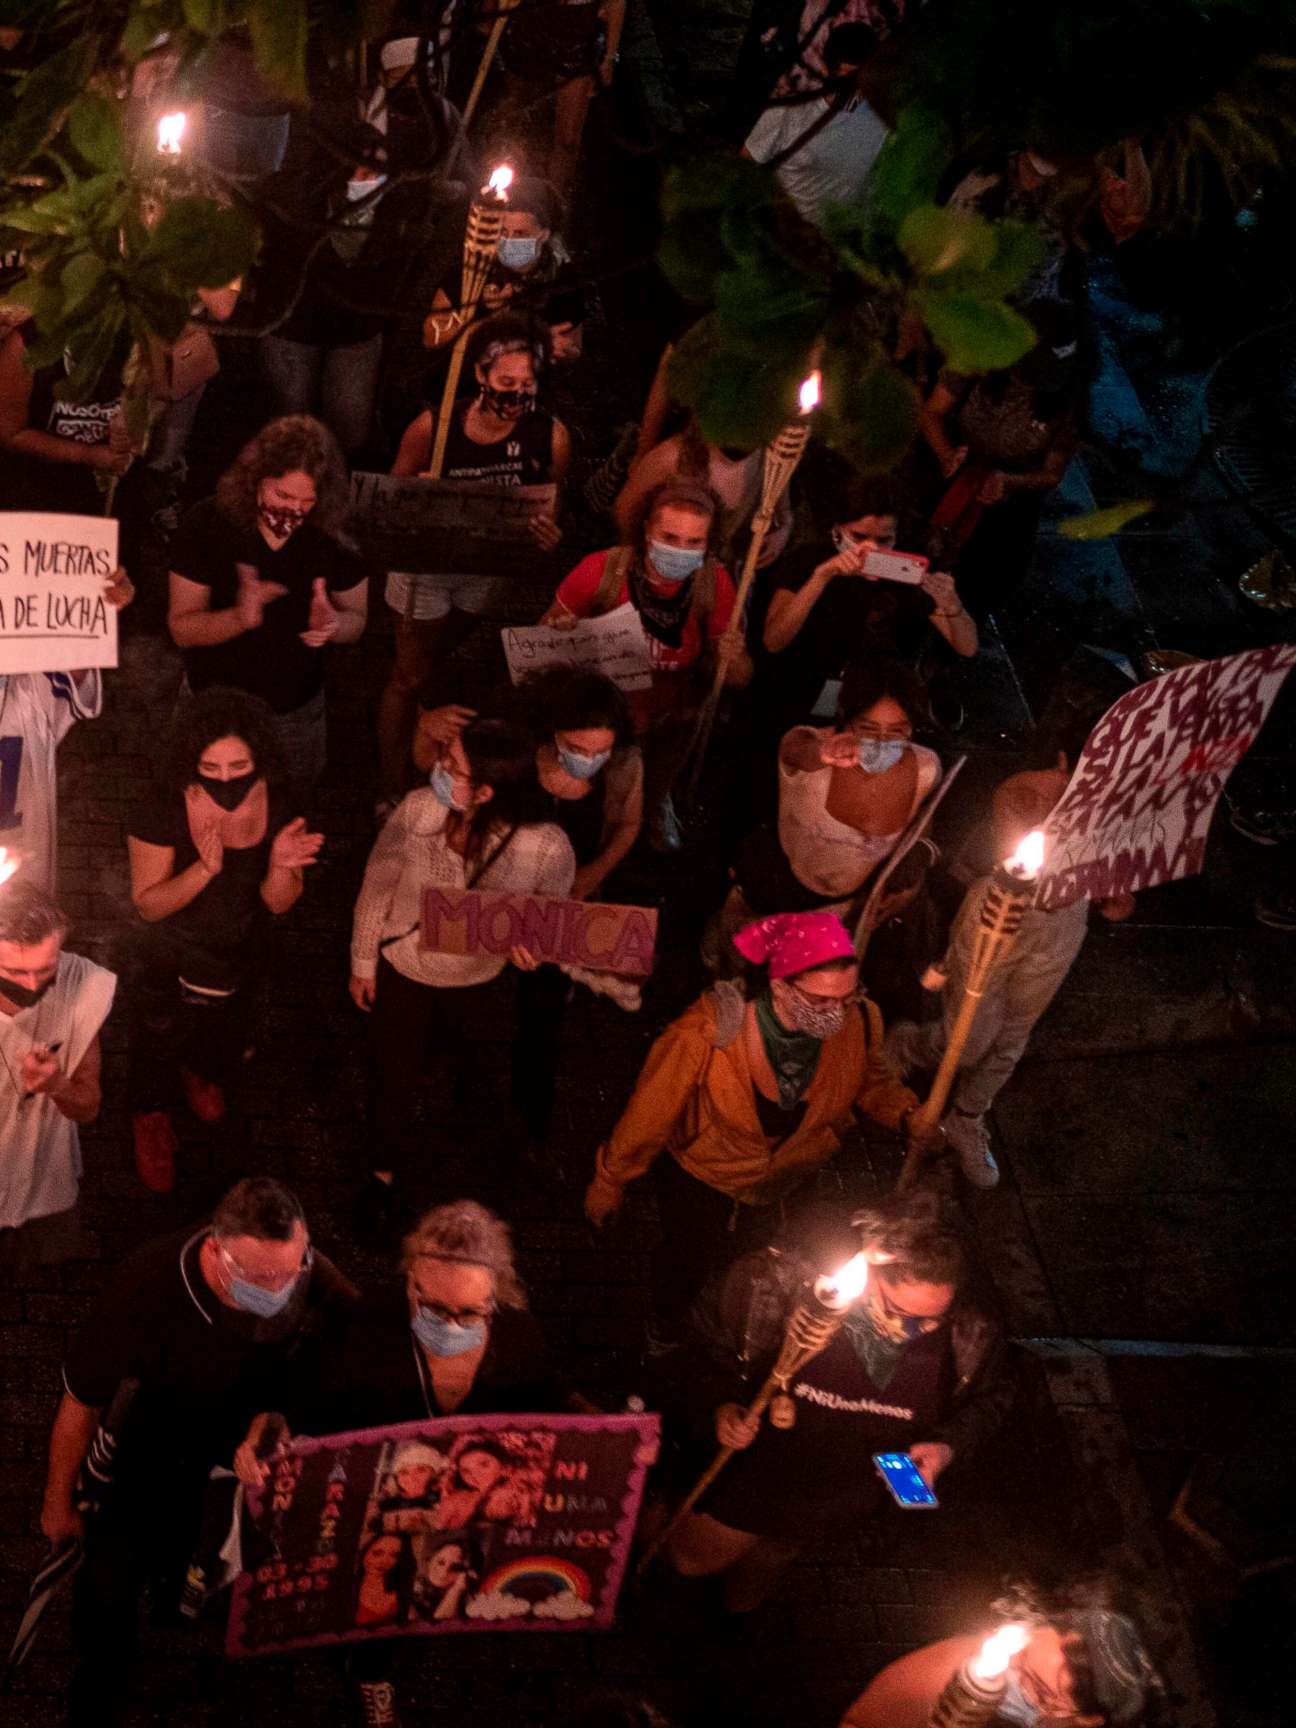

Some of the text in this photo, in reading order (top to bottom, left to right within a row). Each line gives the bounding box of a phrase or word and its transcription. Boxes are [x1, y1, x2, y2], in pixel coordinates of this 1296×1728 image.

[24, 540, 111, 577] MUERTAS
[14, 594, 39, 630] DE
[46, 592, 108, 635] LUCHA
[555, 1460, 589, 1482] NI
